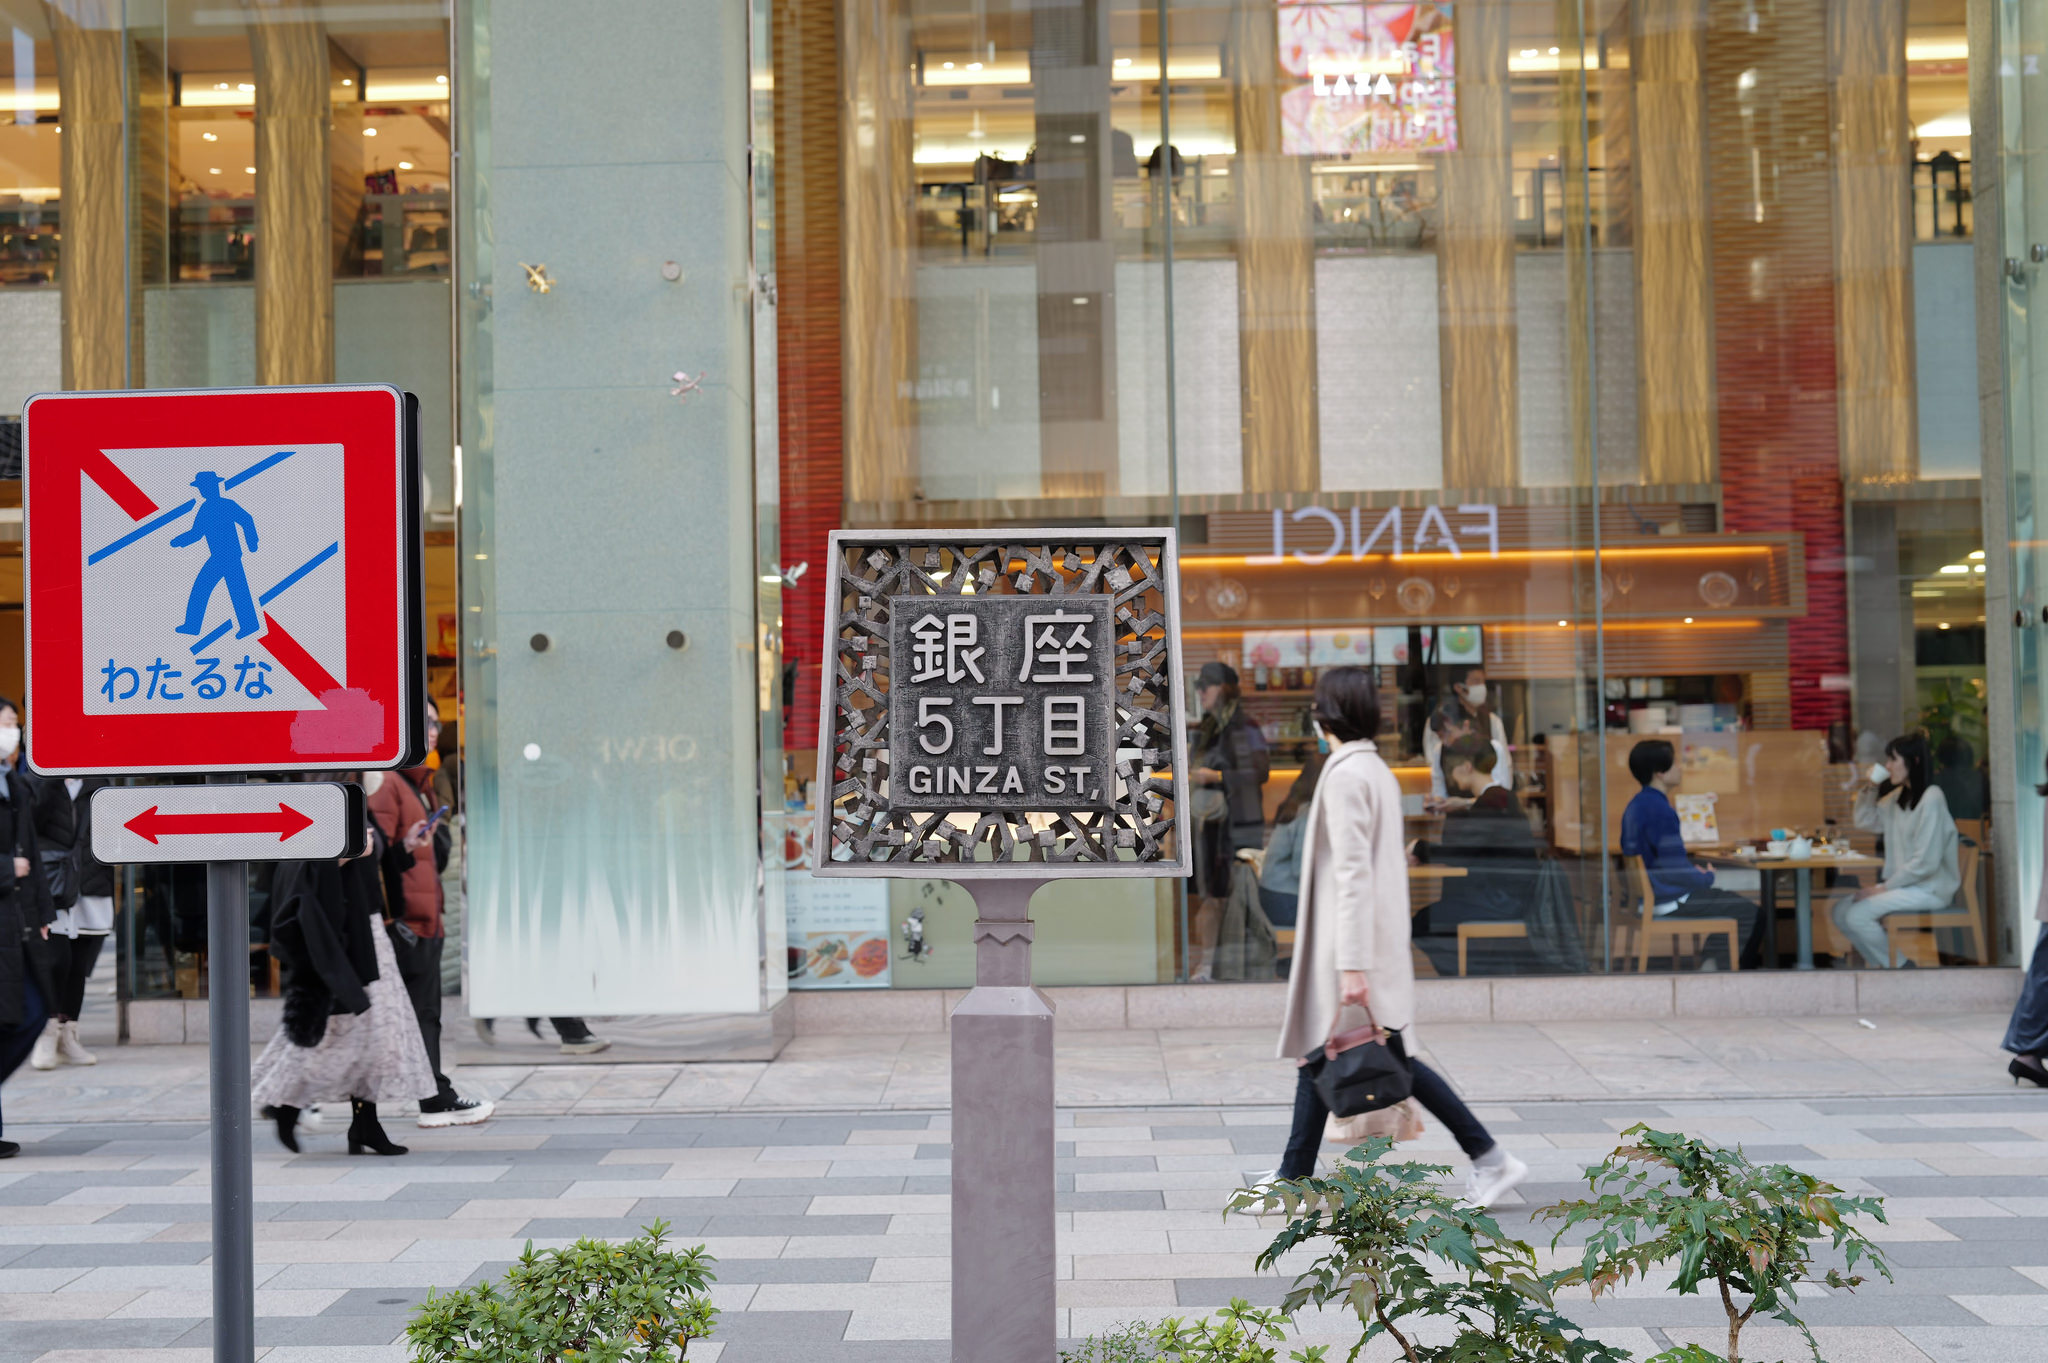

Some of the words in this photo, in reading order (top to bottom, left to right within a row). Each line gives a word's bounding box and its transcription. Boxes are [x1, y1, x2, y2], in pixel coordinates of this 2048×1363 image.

[910, 609, 1094, 684] 銀座
[101, 655, 272, 703] わたるな
[918, 696, 1085, 755] 5丁目
[909, 766, 1024, 794] GINZA
